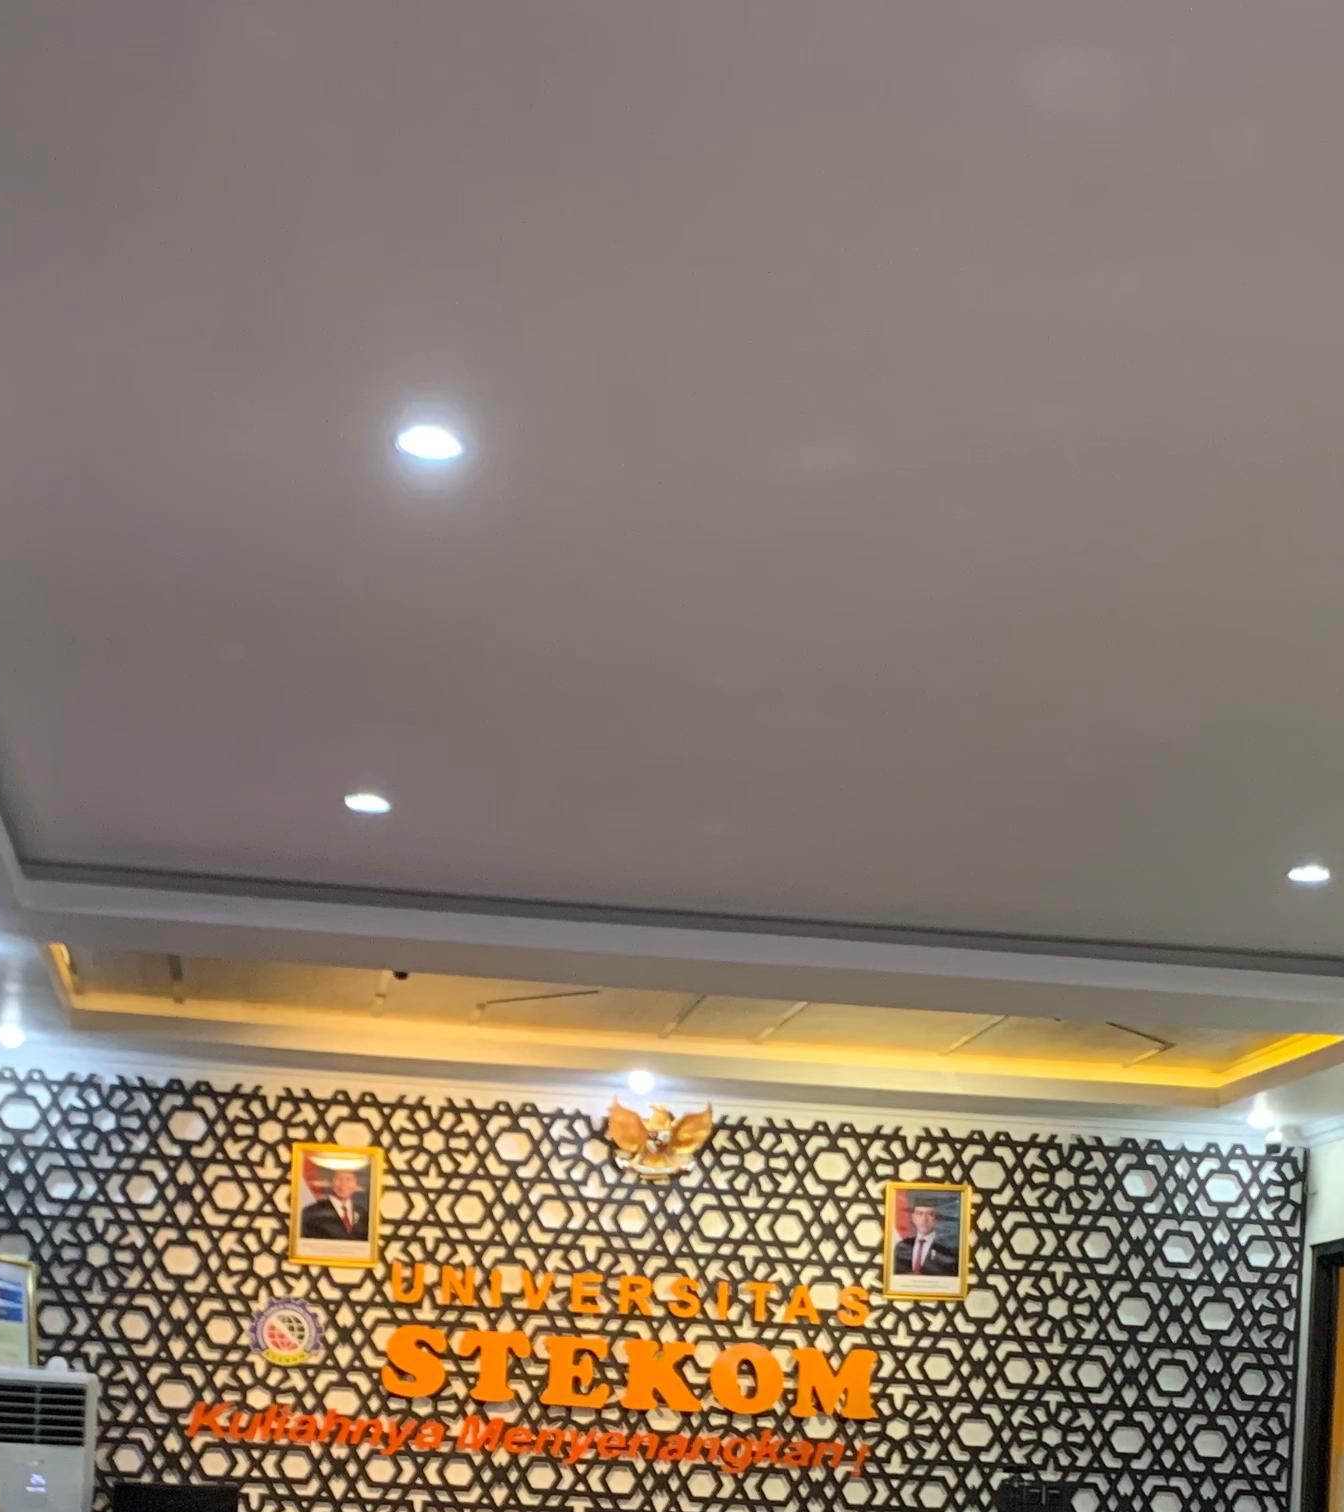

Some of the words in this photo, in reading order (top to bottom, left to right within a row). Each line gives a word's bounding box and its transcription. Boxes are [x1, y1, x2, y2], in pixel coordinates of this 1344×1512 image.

[389, 1258, 873, 1327] UNIVERSITAS
[380, 1323, 879, 1419] STEKOM
[187, 1399, 447, 1456] Kuliahnya
